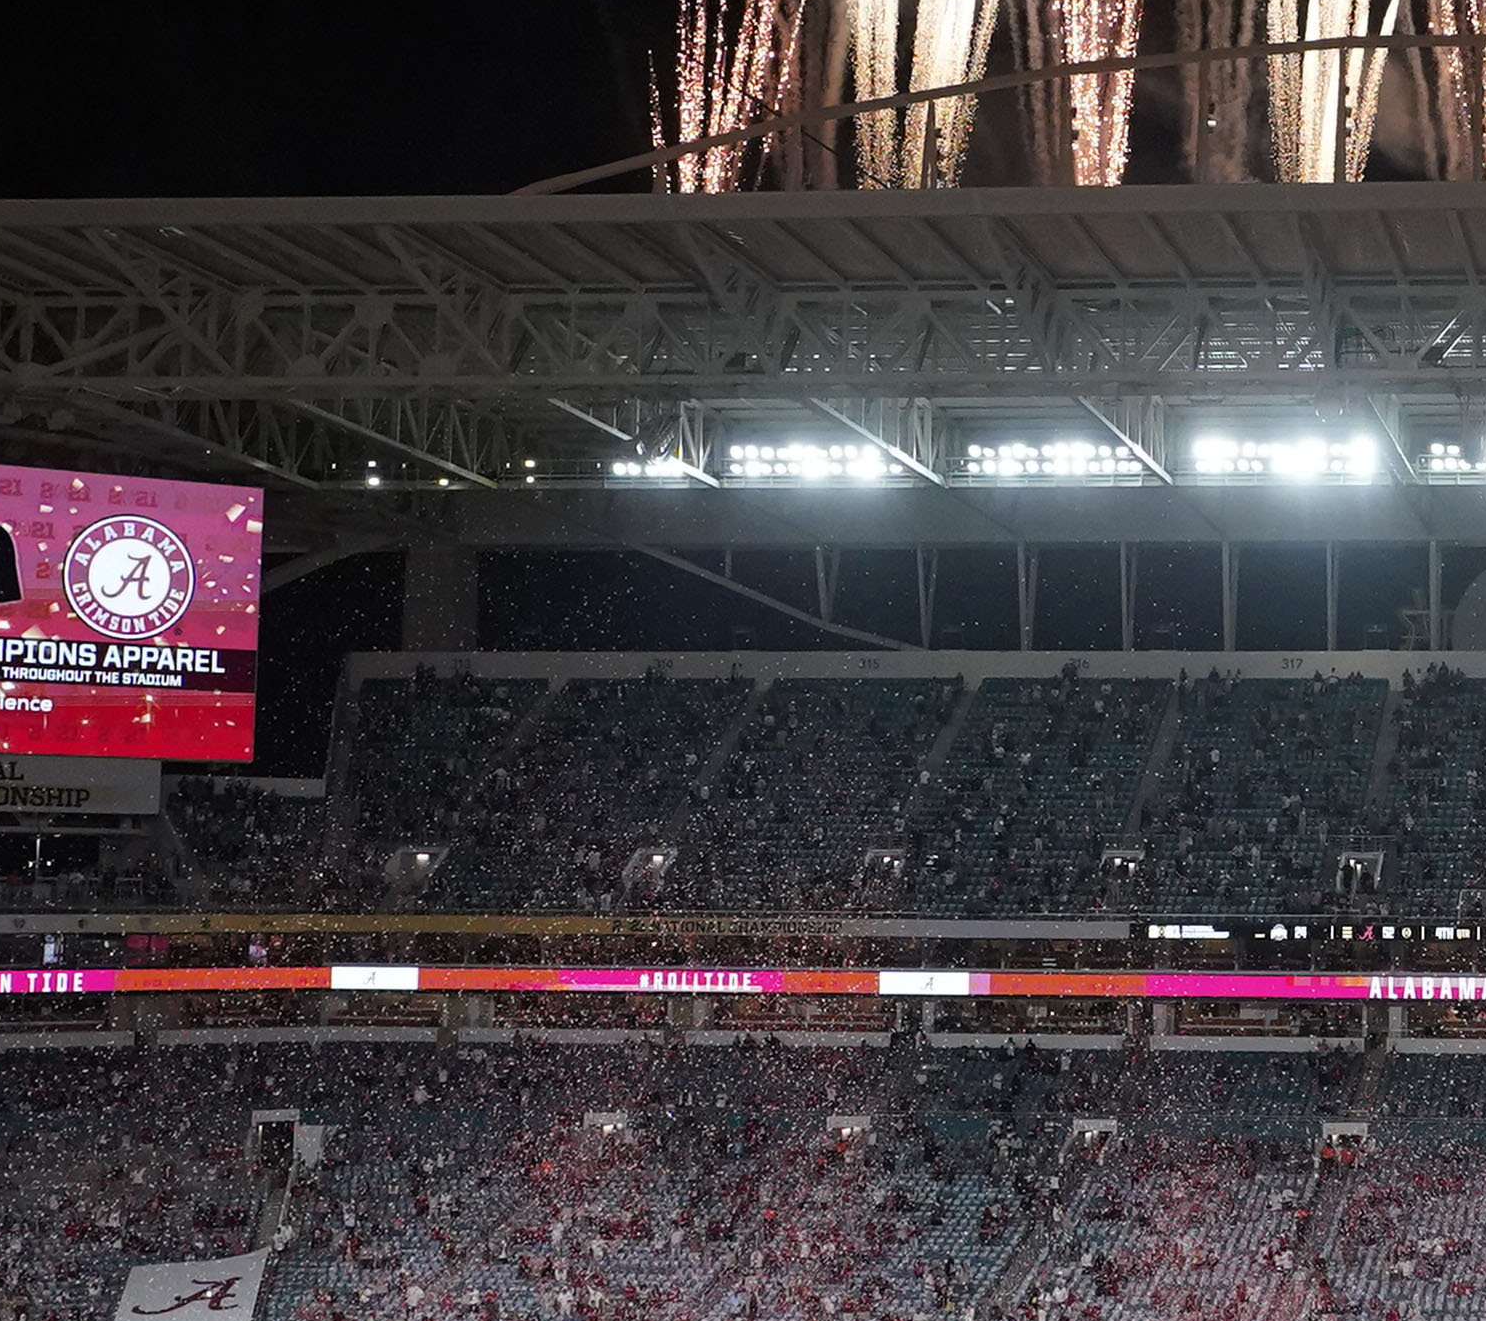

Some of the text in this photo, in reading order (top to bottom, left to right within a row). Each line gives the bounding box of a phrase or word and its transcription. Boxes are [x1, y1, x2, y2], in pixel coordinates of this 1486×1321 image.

[74, 521, 186, 574] ALABAMA
[101, 551, 153, 601] A
[73, 581, 186, 634] CRIMSON TIDE
[103, 644, 226, 674] APPAREL
[2, 667, 91, 684] THROUGHOUT
[94, 670, 119, 684] THE
[122, 672, 182, 687] STADIUM
[1435, 927, 1454, 939] 4TH
[26, 972, 86, 995] TIDE
[638, 971, 753, 992] #ROLLTIDE
[133, 1276, 242, 1316] A
